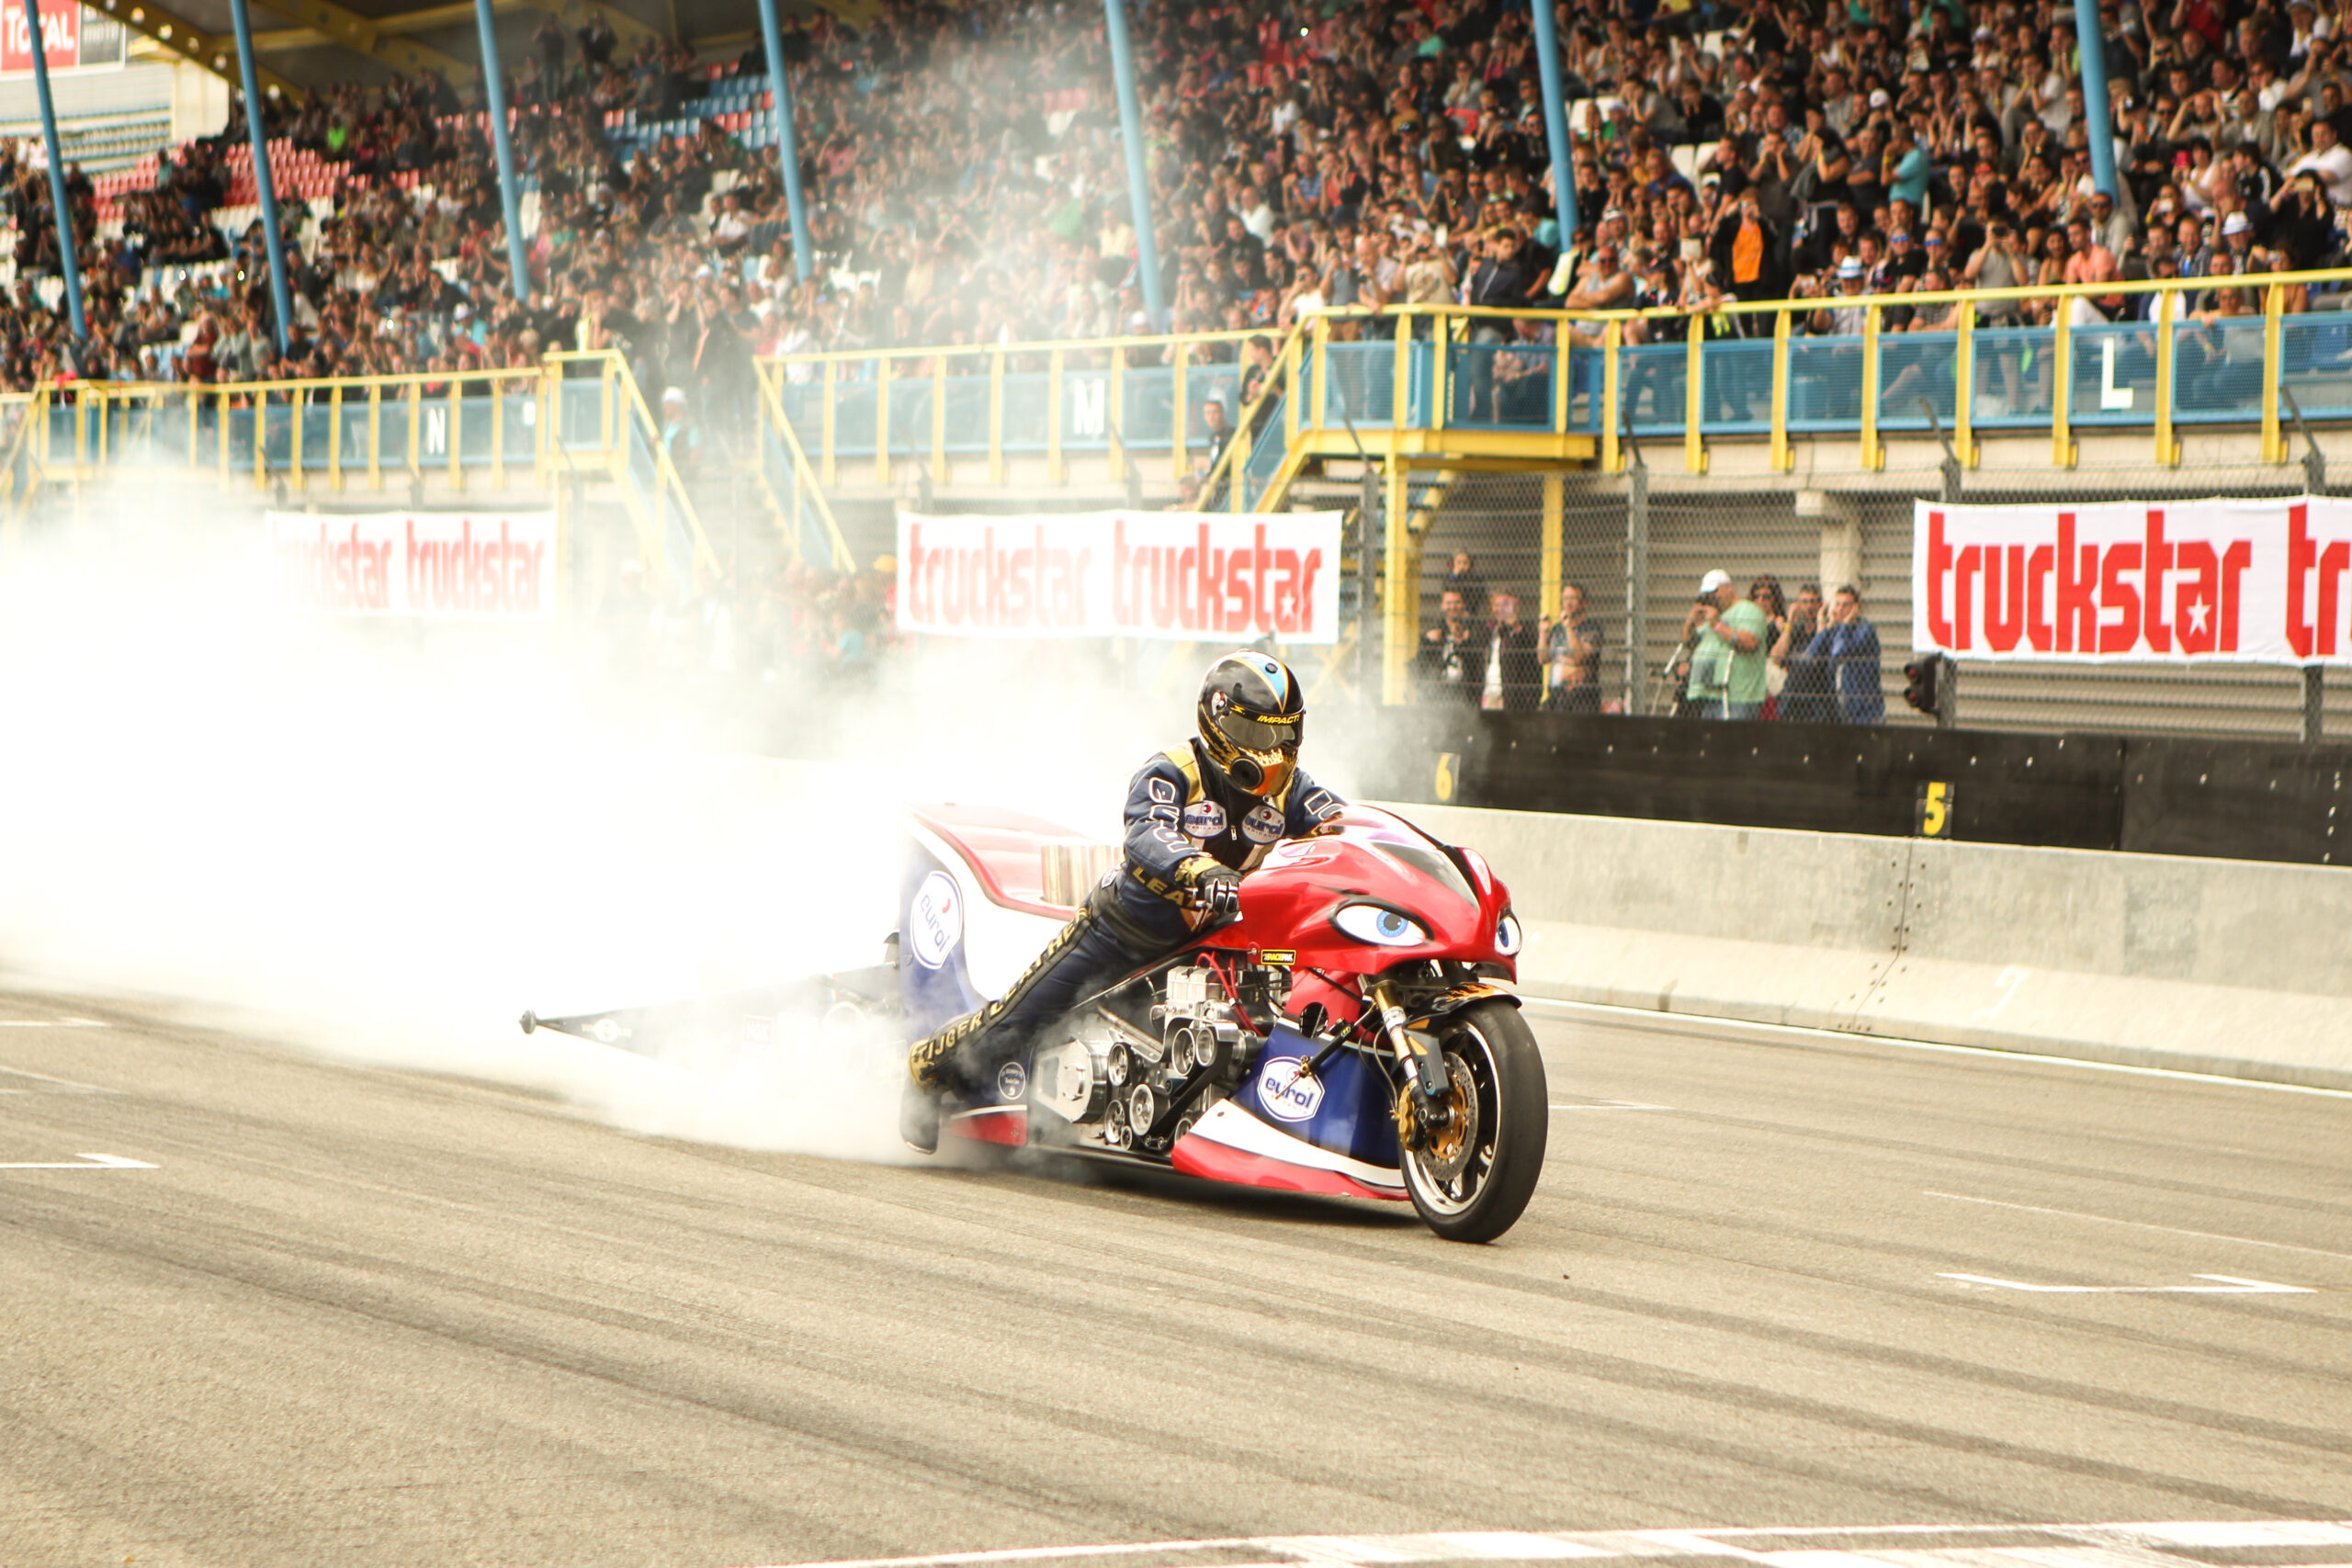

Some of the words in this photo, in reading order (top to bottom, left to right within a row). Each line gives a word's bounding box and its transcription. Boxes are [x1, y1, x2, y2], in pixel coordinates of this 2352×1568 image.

[2101, 337, 2133, 409] L
[428, 407, 446, 455] N
[1073, 378, 1104, 434] M
[406, 518, 545, 612] truckstar
[909, 521, 1092, 626] truckstar
[1114, 519, 1322, 633] truckstar
[1928, 509, 2252, 655] truckstar
[1435, 753, 1453, 802] 6
[1923, 782, 1946, 836] 5
[921, 894, 951, 953] eurol
[1265, 1077, 1315, 1109] eurol
